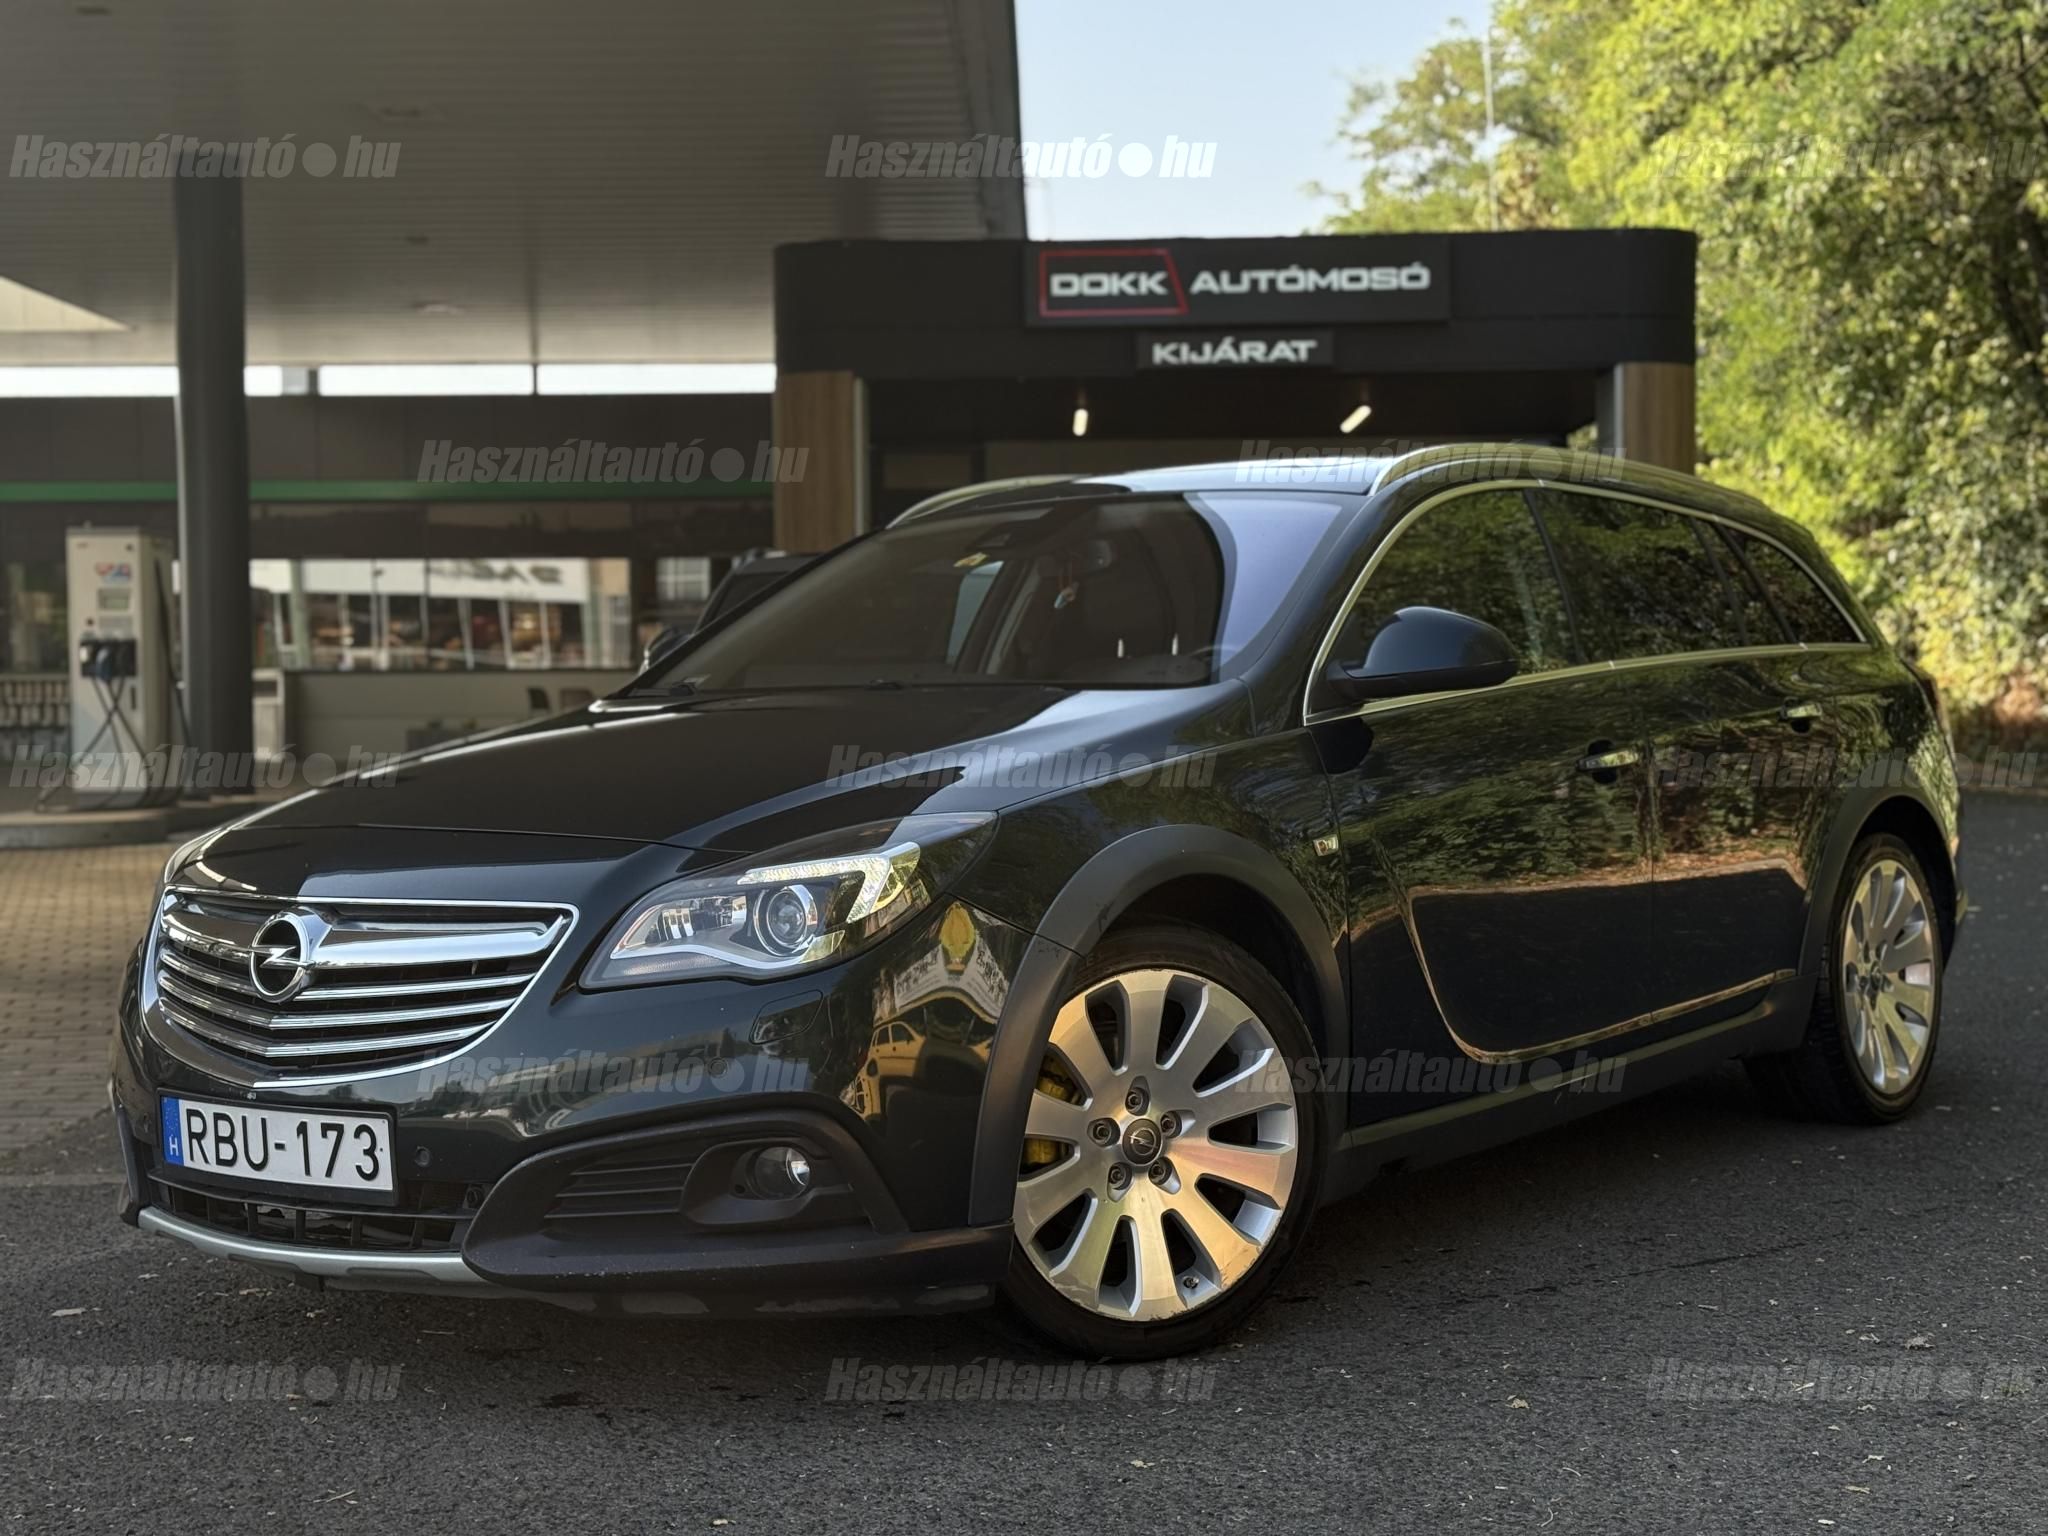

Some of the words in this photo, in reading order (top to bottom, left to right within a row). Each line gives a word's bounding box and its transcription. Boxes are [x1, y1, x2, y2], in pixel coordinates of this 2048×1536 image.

[1050, 271, 1168, 297] DOKK
[1190, 263, 1431, 294] AUTÓMOSÓ
[1153, 337, 1318, 364] KIJÁRAT
[169, 1136, 179, 1157] H
[186, 1108, 380, 1181] RBU-173
